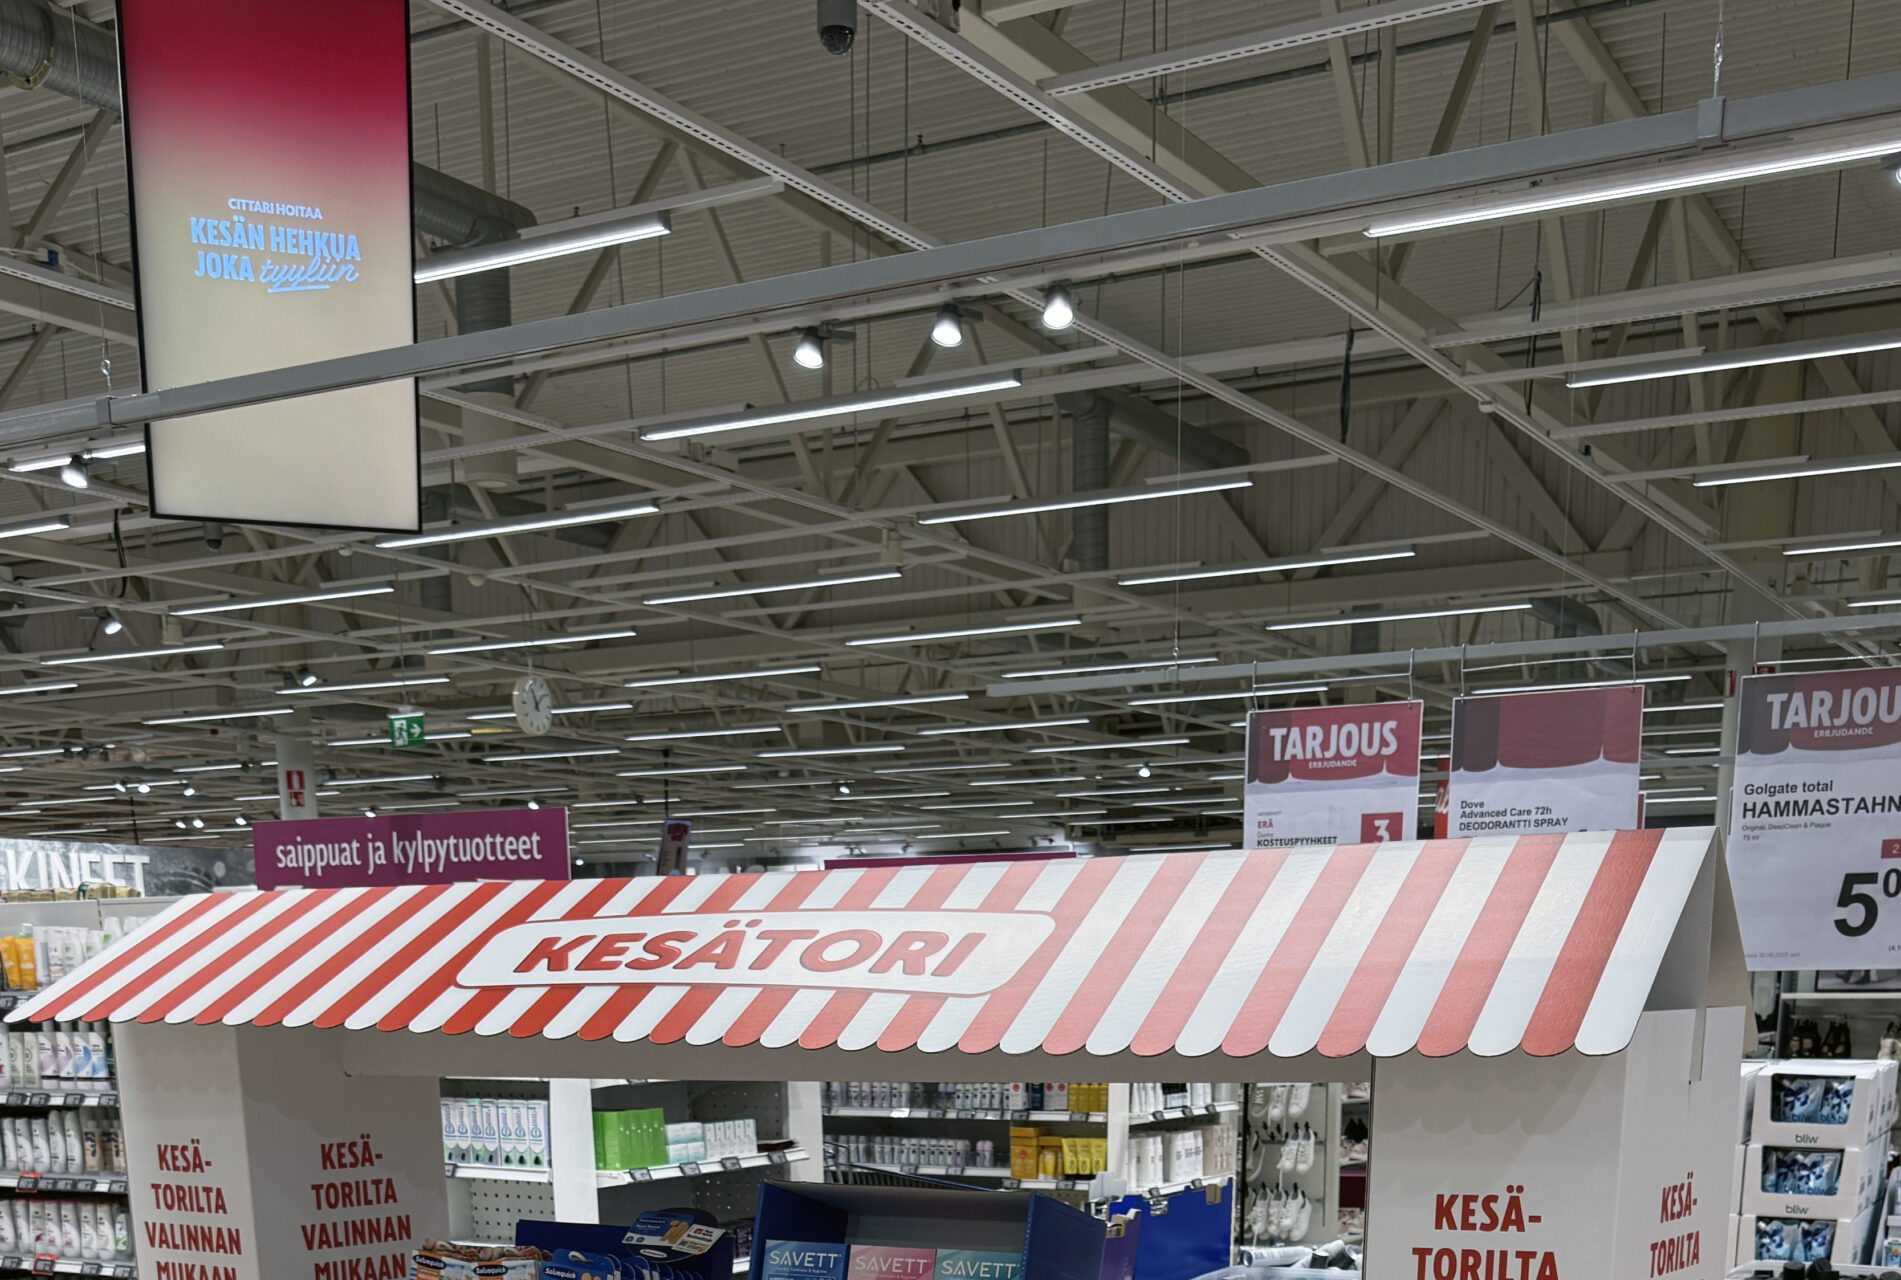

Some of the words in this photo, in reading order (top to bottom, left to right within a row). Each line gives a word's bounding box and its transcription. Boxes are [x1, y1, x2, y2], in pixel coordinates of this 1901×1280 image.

[228, 198, 274, 214] CITTARI
[276, 204, 322, 219] HOITAA
[190, 216, 264, 251] KESÄN
[270, 227, 360, 261] HEHKUA
[195, 251, 255, 281] JOKA
[259, 256, 359, 291] tyyliin
[1270, 721, 1398, 761] TARJOUS
[1814, 728, 1873, 738] ERBJUDANDE
[1309, 760, 1357, 768] ERBJUDANDE
[1802, 781, 1833, 792] total
[1460, 809, 1507, 819] Advanced
[1510, 808, 1532, 816] Care
[1535, 807, 1552, 815] 72h
[1461, 801, 1484, 809] Dove
[1374, 819, 1390, 843] 3
[1459, 820, 1531, 831] DEODORANTTI
[1534, 818, 1568, 827] SPRAY
[277, 837, 361, 877] saippuat
[367, 834, 386, 874] ja
[393, 830, 542, 873] kylpytuotteet
[1257, 836, 1337, 847] KOSTEUSPYYHKEET
[512, 919, 986, 978] KESÄTORI
[321, 1134, 383, 1170] KESÄ-
[1795, 1134, 1820, 1144] bliw
[157, 1139, 212, 1173] KESÄ-
[151, 1183, 228, 1214] TORILTA
[311, 1178, 398, 1210] TORILTA
[1434, 1185, 1542, 1232] KESÄ-
[1660, 1171, 1698, 1223] KESÄ-
[1786, 1205, 1809, 1215] bliw
[144, 1222, 242, 1255] VALINNAN
[301, 1214, 412, 1251] VALINNAN
[769, 1250, 838, 1268] SAVETT
[942, 1260, 1016, 1279] SAVETT
[1650, 1231, 1699, 1278] TORILTA
